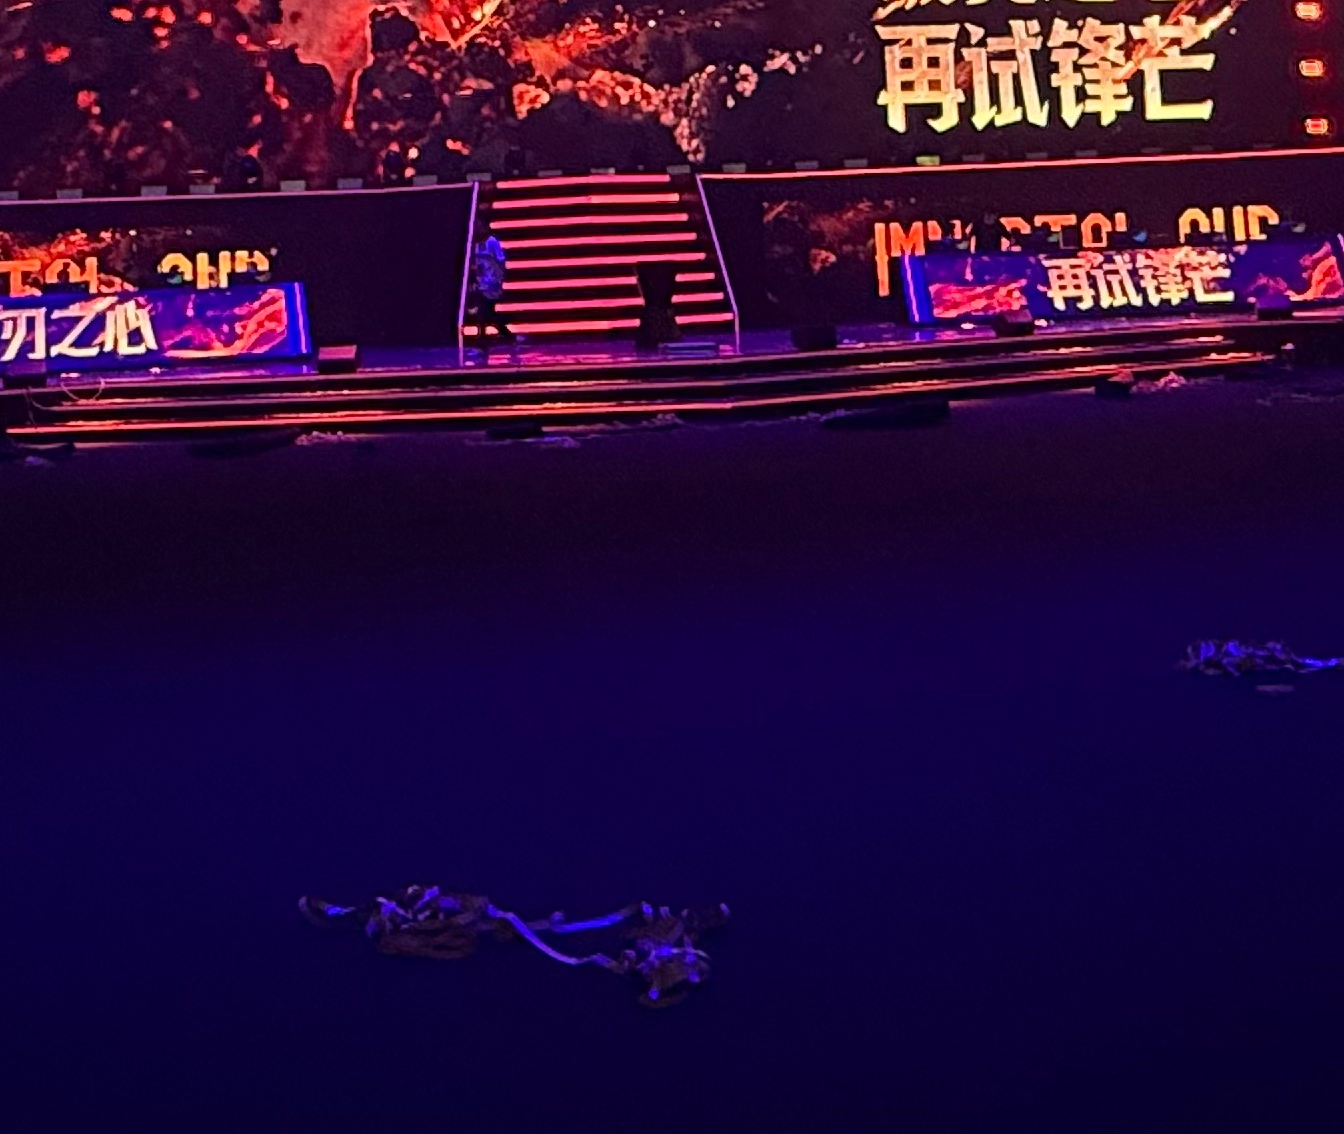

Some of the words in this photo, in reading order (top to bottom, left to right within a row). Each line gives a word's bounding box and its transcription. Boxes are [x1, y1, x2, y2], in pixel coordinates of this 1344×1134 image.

[875, 15, 1216, 134] 再试锋芒
[1041, 247, 1235, 311] 再试锋芒
